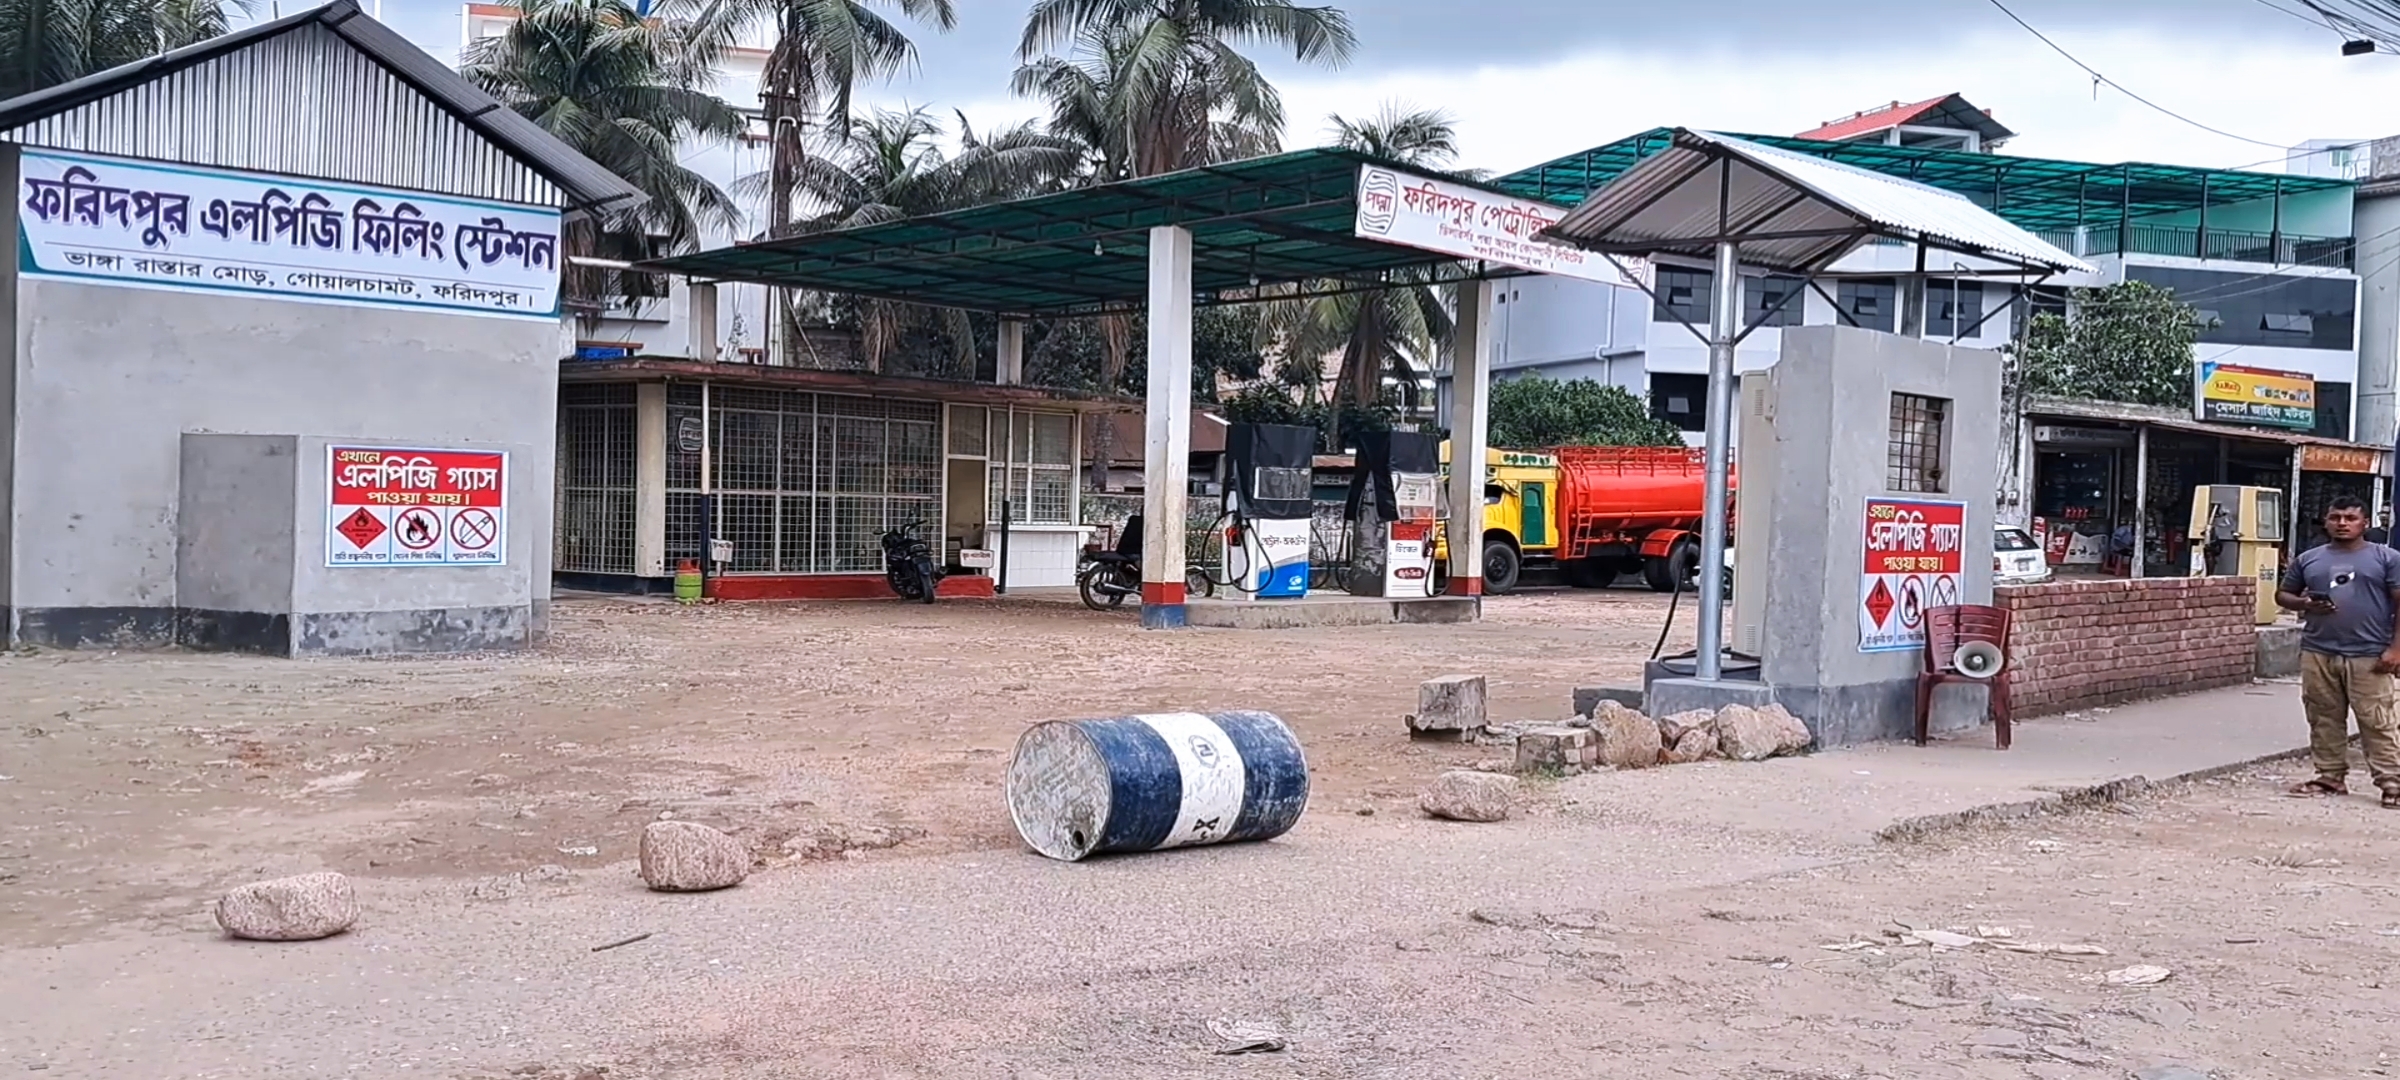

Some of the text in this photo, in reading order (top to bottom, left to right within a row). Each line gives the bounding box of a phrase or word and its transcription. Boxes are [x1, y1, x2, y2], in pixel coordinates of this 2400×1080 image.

[1365, 191, 1392, 213] পদ্মা
[1403, 182, 1477, 228] ফরিদপুর
[25, 166, 556, 270] ফরিদপুর এলপিজি ফিলিং স্টেশন
[64, 251, 123, 272] ভাঙ্গা
[132, 257, 201, 277] রাস্তার
[212, 264, 275, 287] মোড়,
[287, 271, 421, 299] গোয়ালচামট,
[336, 451, 380, 463] এখানে
[336, 456, 498, 491] এলপিজি গ্যাস
[366, 492, 420, 504] পাওয়া
[1868, 504, 1895, 519] এখানে
[1867, 510, 1960, 552] এলপিজি গ্যাস
[1884, 557, 1915, 572] পাওয়া
